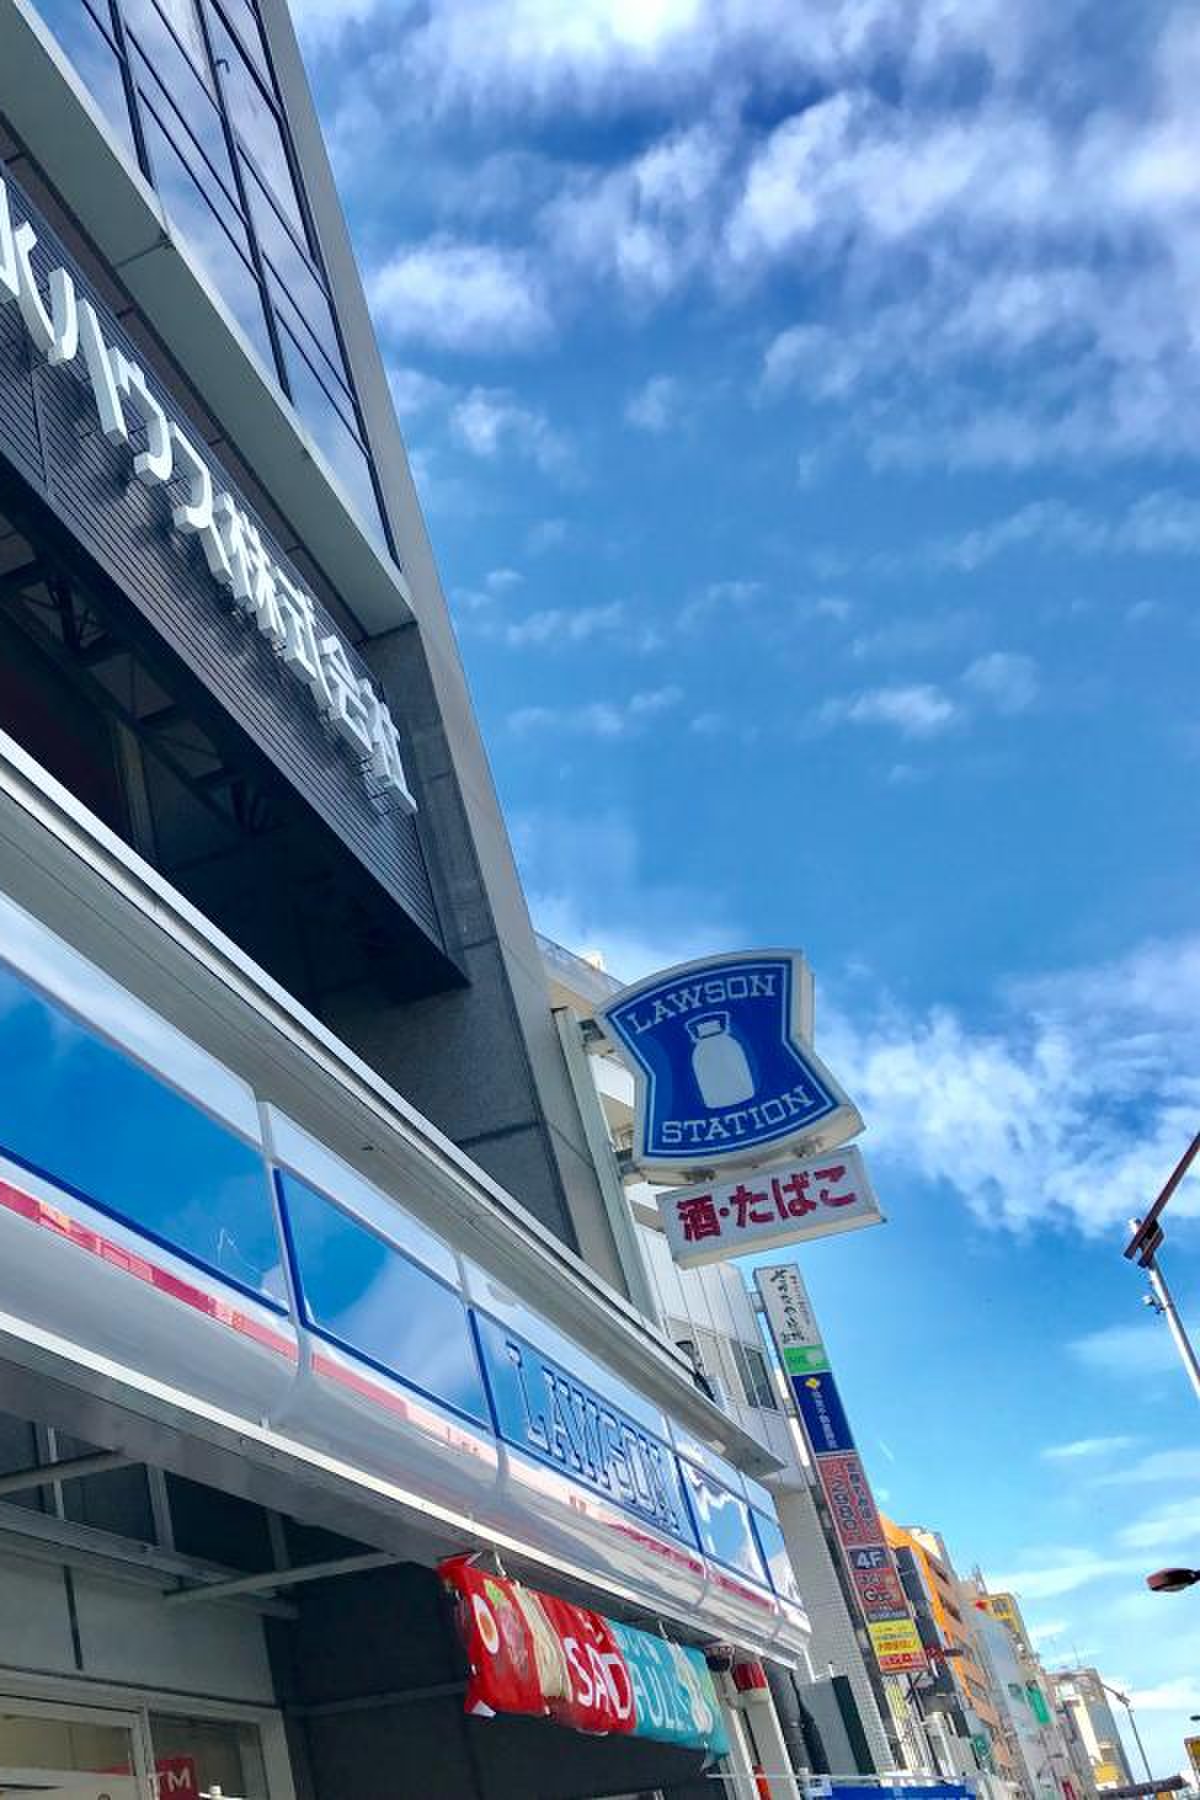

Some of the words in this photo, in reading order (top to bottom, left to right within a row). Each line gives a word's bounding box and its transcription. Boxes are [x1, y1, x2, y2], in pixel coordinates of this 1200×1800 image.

[626, 973, 778, 1035] LAWSON
[660, 1083, 815, 1144] STATION
[676, 1164, 859, 1244] 酒・たばこ
[505, 1339, 681, 1534] LAWSON
[856, 1551, 883, 1569] 4F
